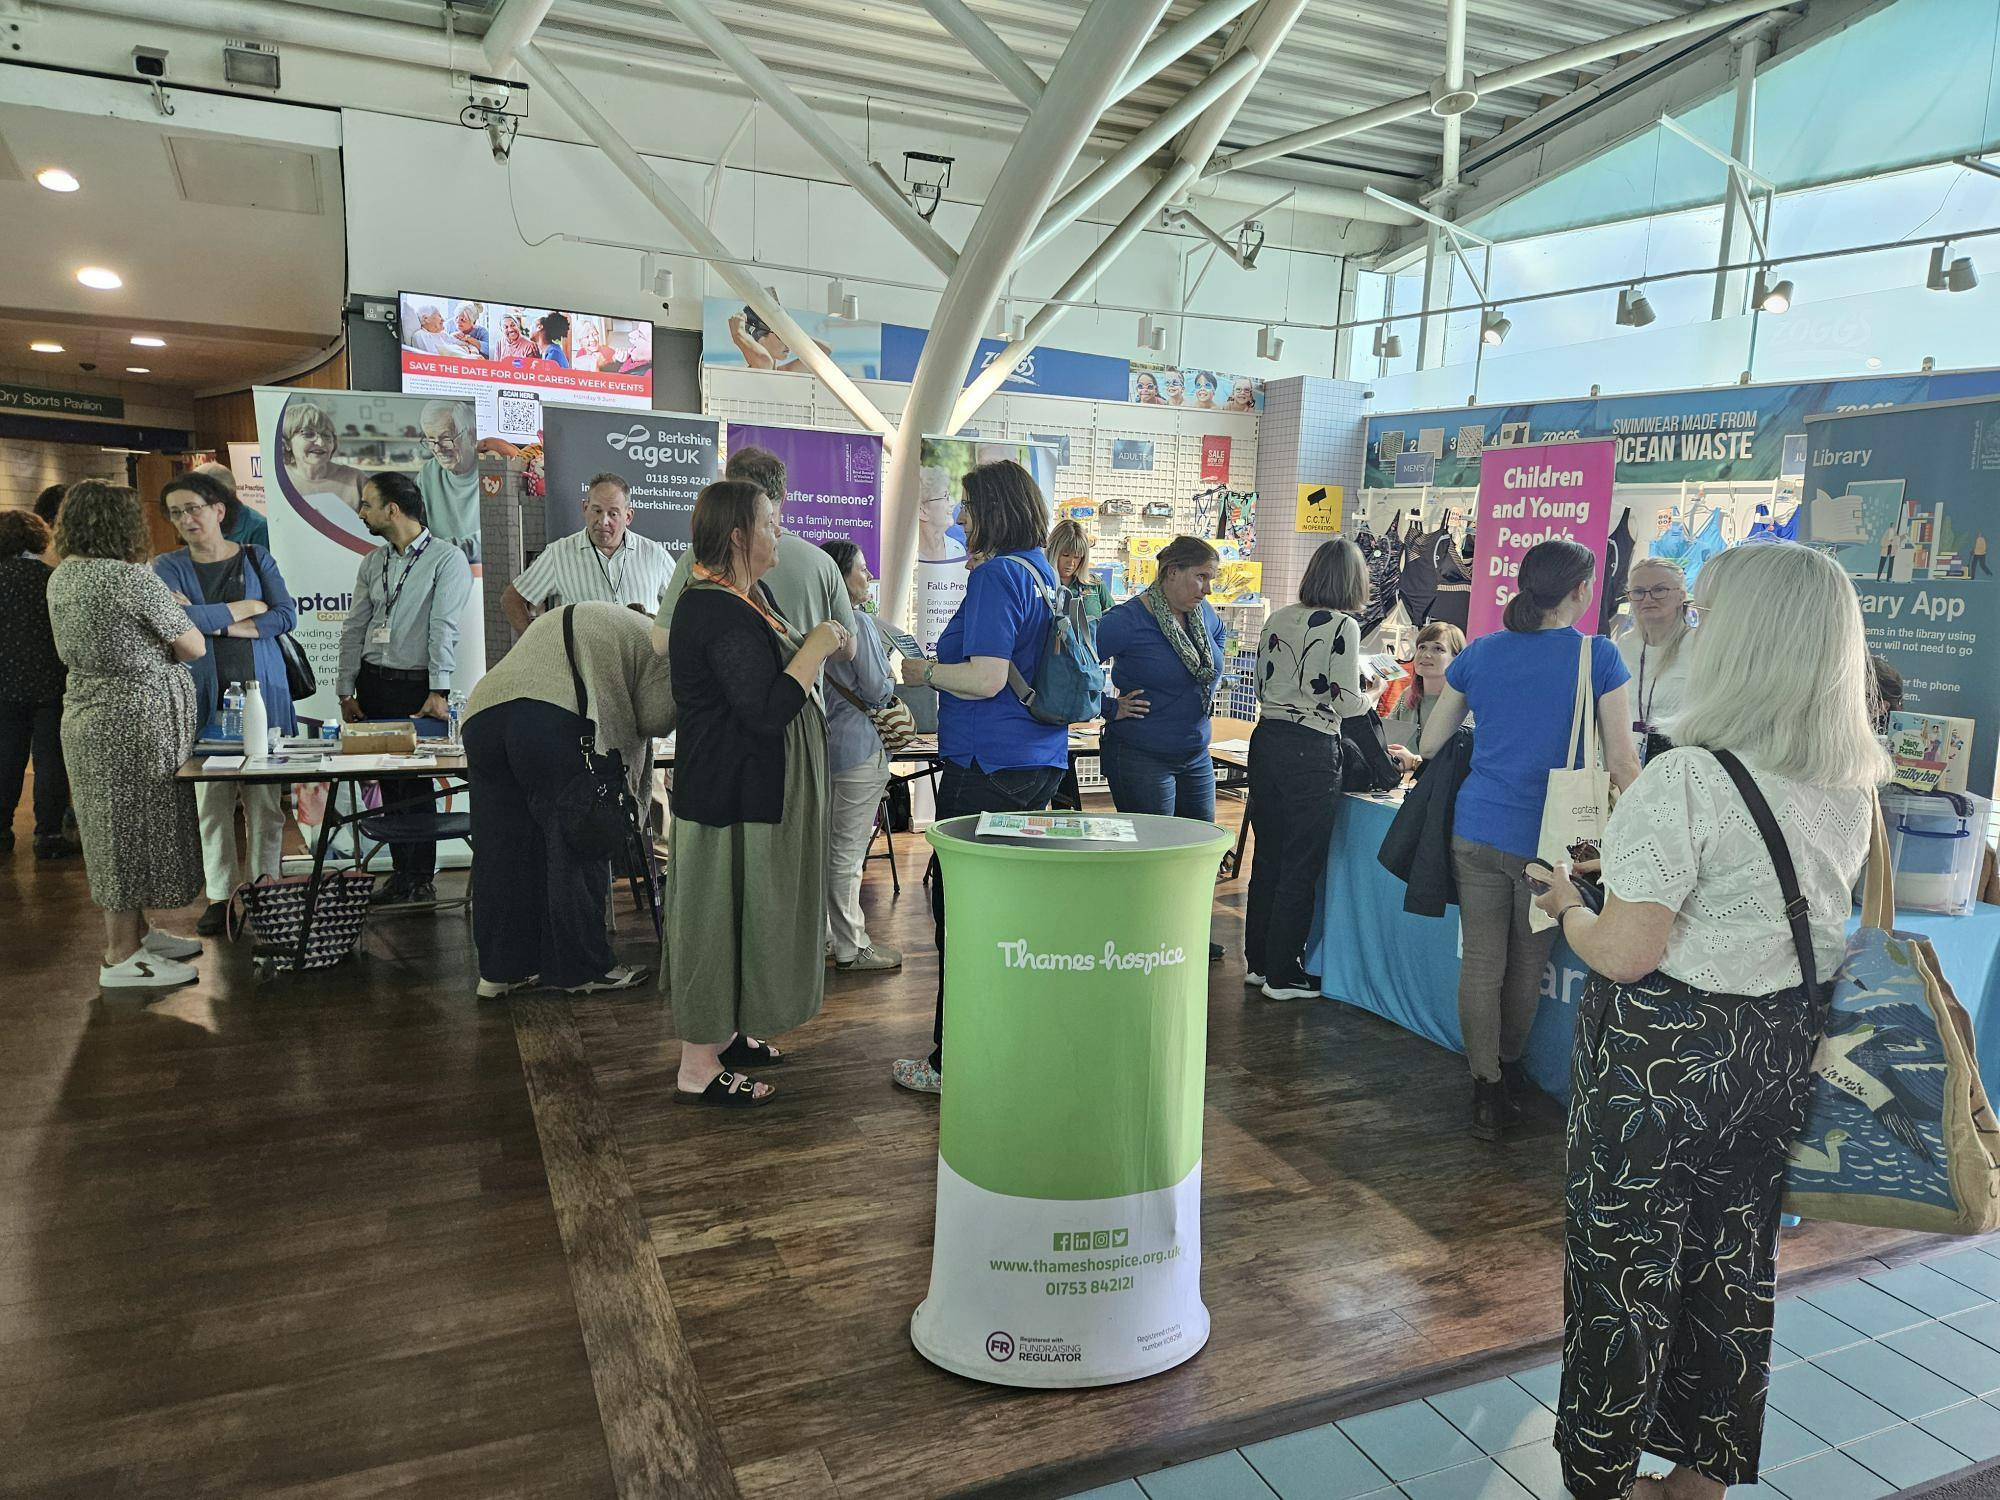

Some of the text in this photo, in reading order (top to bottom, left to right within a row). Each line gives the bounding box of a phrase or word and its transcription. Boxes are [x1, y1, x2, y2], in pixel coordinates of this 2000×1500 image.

[981, 351, 1035, 377] ZGS
[409, 361, 645, 393] SAVE THE DATE FOR OUR CARERS WEEK EVENTS
[0, 389, 102, 412] Dry Sports Pavilion
[518, 392, 535, 400] HERE
[1612, 410, 1758, 436] SWIMWEAR MADE FROM
[658, 430, 712, 446] Berkshire
[1450, 437, 1457, 450] 3
[1491, 434, 1498, 446] 4
[1541, 430, 1581, 442] ZOGGS
[1208, 449, 1225, 459] SALE
[1410, 440, 1416, 453] 2
[1681, 431, 1756, 463] WASTE
[1812, 448, 1873, 467] Library
[482, 476, 500, 494] ty
[646, 473, 711, 487] 0118 959 4242
[1503, 464, 1584, 490] Children
[786, 490, 875, 506] after someone?
[1492, 496, 1590, 524] and Young
[786, 513, 795, 523] is
[797, 516, 804, 524] a
[805, 514, 833, 528] family
[835, 518, 874, 529] member,
[1306, 515, 1332, 525] C.C.T.V.
[803, 529, 851, 540] neighbour.
[927, 581, 948, 591] Falls
[927, 599, 943, 607] Early
[1911, 590, 1966, 622] App
[1887, 626, 1896, 636] in
[1898, 628, 1914, 637] the
[1916, 628, 1946, 641] library
[1948, 631, 1976, 643] using
[1884, 641, 1900, 650] will
[1902, 642, 1918, 651] not
[1920, 644, 1943, 653] need
[1946, 644, 1957, 654] to
[1959, 647, 1973, 657] go
[1913, 678, 1928, 688] the
[1929, 681, 1960, 692] phone
[1571, 805, 1600, 815] contact
[997, 938, 1186, 976] Thames hospice
[989, 1246, 1181, 1274] www.thameshospice.org.uk
[1046, 1276, 1134, 1296] 01753 842121
[991, 1339, 1010, 1354] FR
[1020, 1344, 1081, 1354] FUNDRAISING
[1019, 1352, 1082, 1362] REGULATOR
